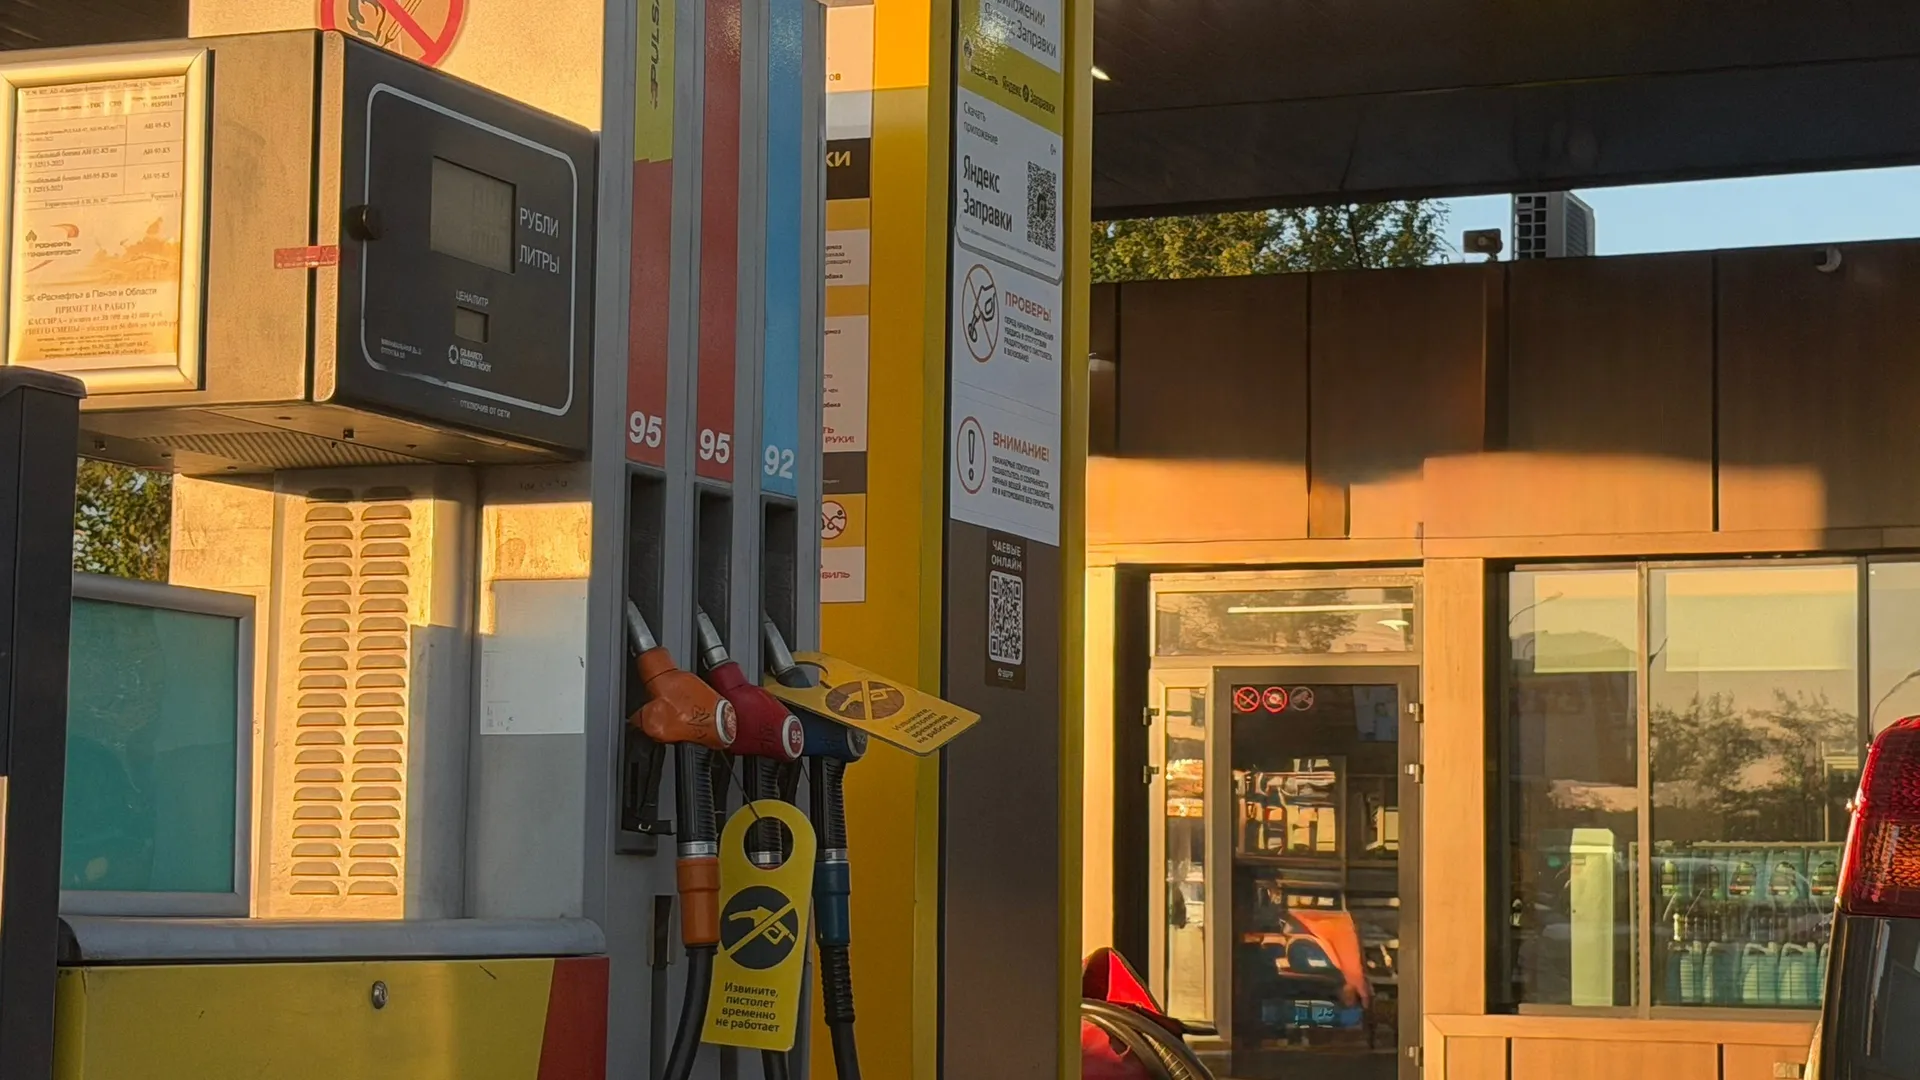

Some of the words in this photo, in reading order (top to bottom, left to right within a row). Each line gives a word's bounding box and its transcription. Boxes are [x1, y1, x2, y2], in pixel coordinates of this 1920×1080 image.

[651, 0, 660, 96] PULS
[1016, 19, 1057, 58] Заправки
[964, 101, 986, 122] Скачать
[964, 121, 998, 145] приложение
[963, 155, 1000, 193] Яндекс
[963, 188, 1013, 232] Заправки
[520, 207, 559, 238] РУБЛИ
[519, 244, 560, 274] ЛИТРЫ
[125, 287, 157, 296] Области
[104, 301, 137, 311] РАБОТУ
[1005, 290, 1052, 323] ПРОВЕРЬ!
[489, 406, 497, 415] ОТ
[497, 408, 511, 418] СЕТИ
[629, 411, 662, 448] 95
[699, 429, 730, 464] 95
[992, 430, 1049, 462] ВНИМАНИЕ!
[764, 444, 794, 479] 92
[992, 540, 1021, 557] ЧАЕВЫЕ
[991, 554, 1022, 571] ОНЛАЙН
[904, 712, 937, 733] пистолет
[911, 715, 948, 738] временно
[917, 736, 929, 744] не
[926, 716, 960, 739] работает
[724, 982, 779, 998] Извините,
[726, 995, 775, 1008] пистолет
[715, 1018, 729, 1027] не
[730, 1019, 780, 1033] работает
[722, 1007, 776, 1020] временно
